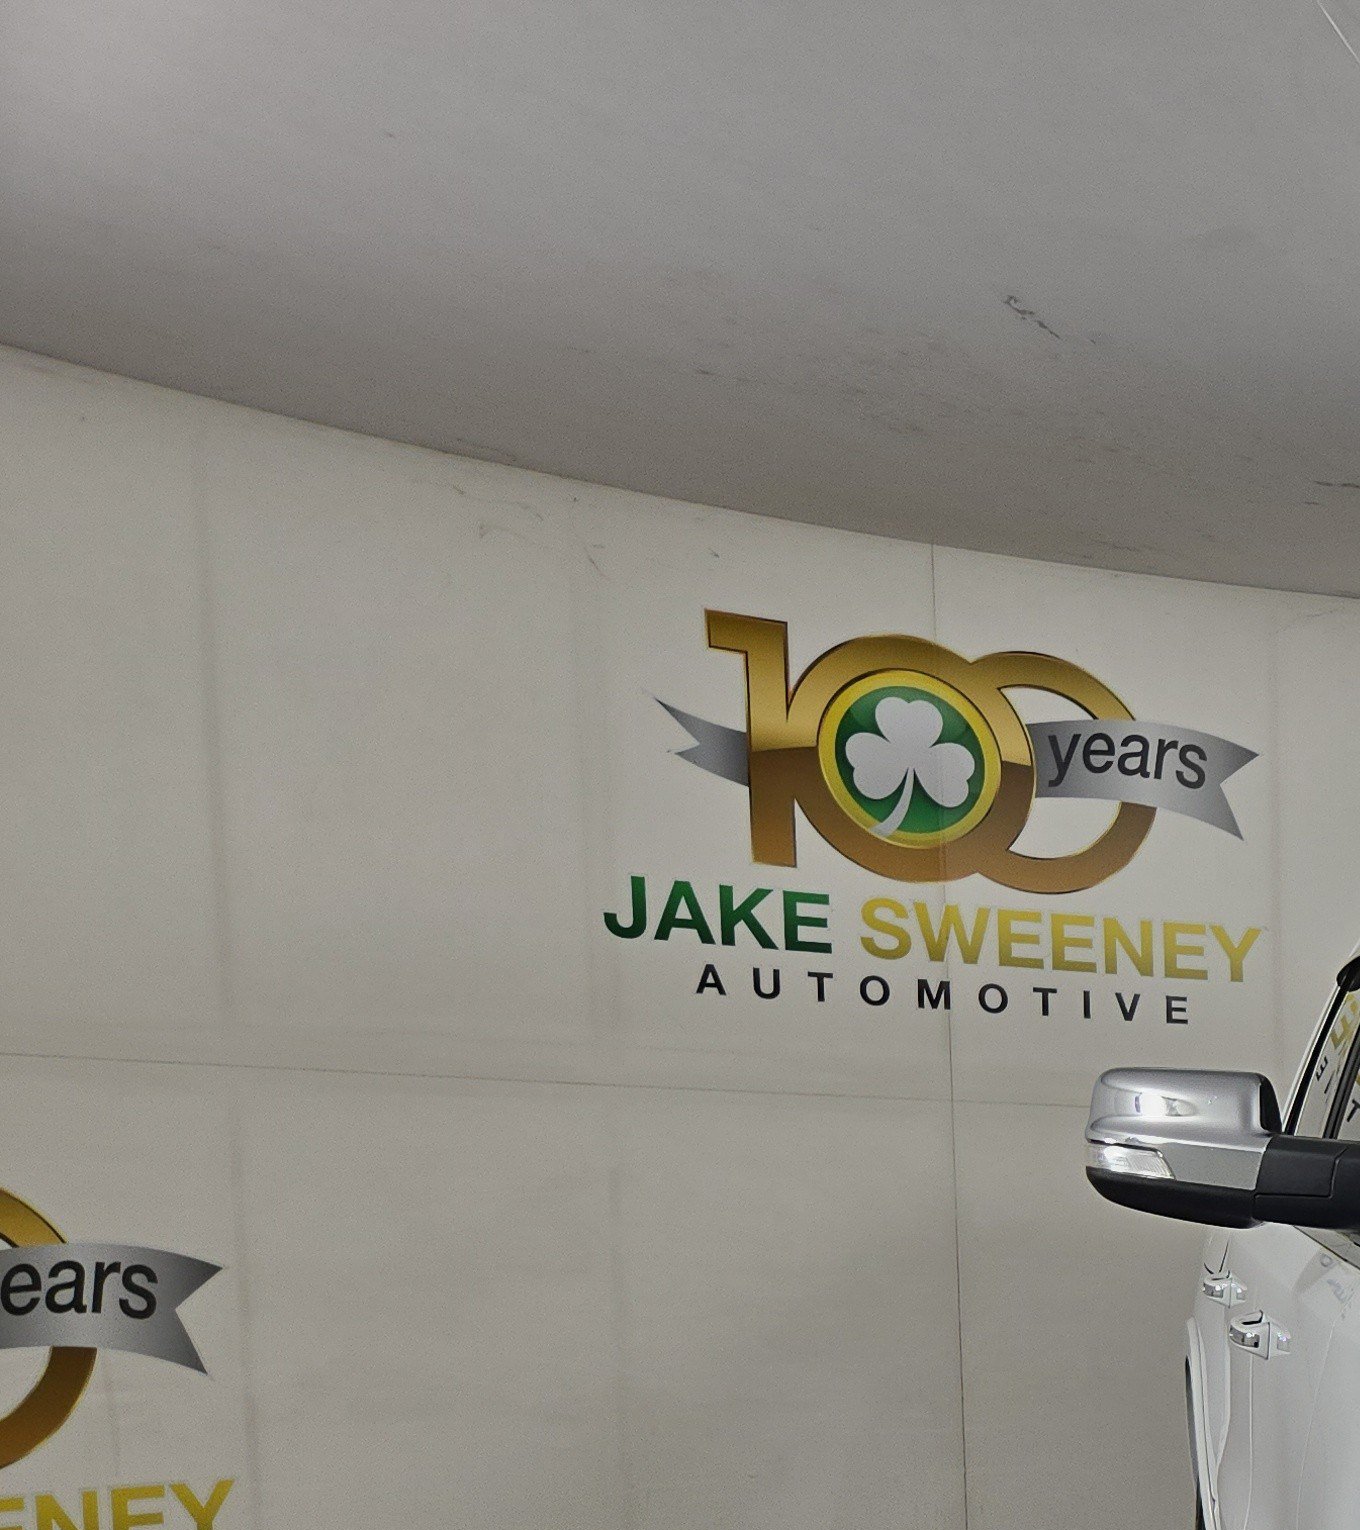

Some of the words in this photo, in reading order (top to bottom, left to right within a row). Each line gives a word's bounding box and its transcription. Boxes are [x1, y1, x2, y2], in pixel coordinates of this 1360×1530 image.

[1047, 731, 1208, 790] years
[603, 875, 832, 954] JAKE
[860, 897, 1261, 983] SWEENEY
[696, 963, 1190, 1025] AUTOMOTIVE
[0, 1257, 159, 1320] ears
